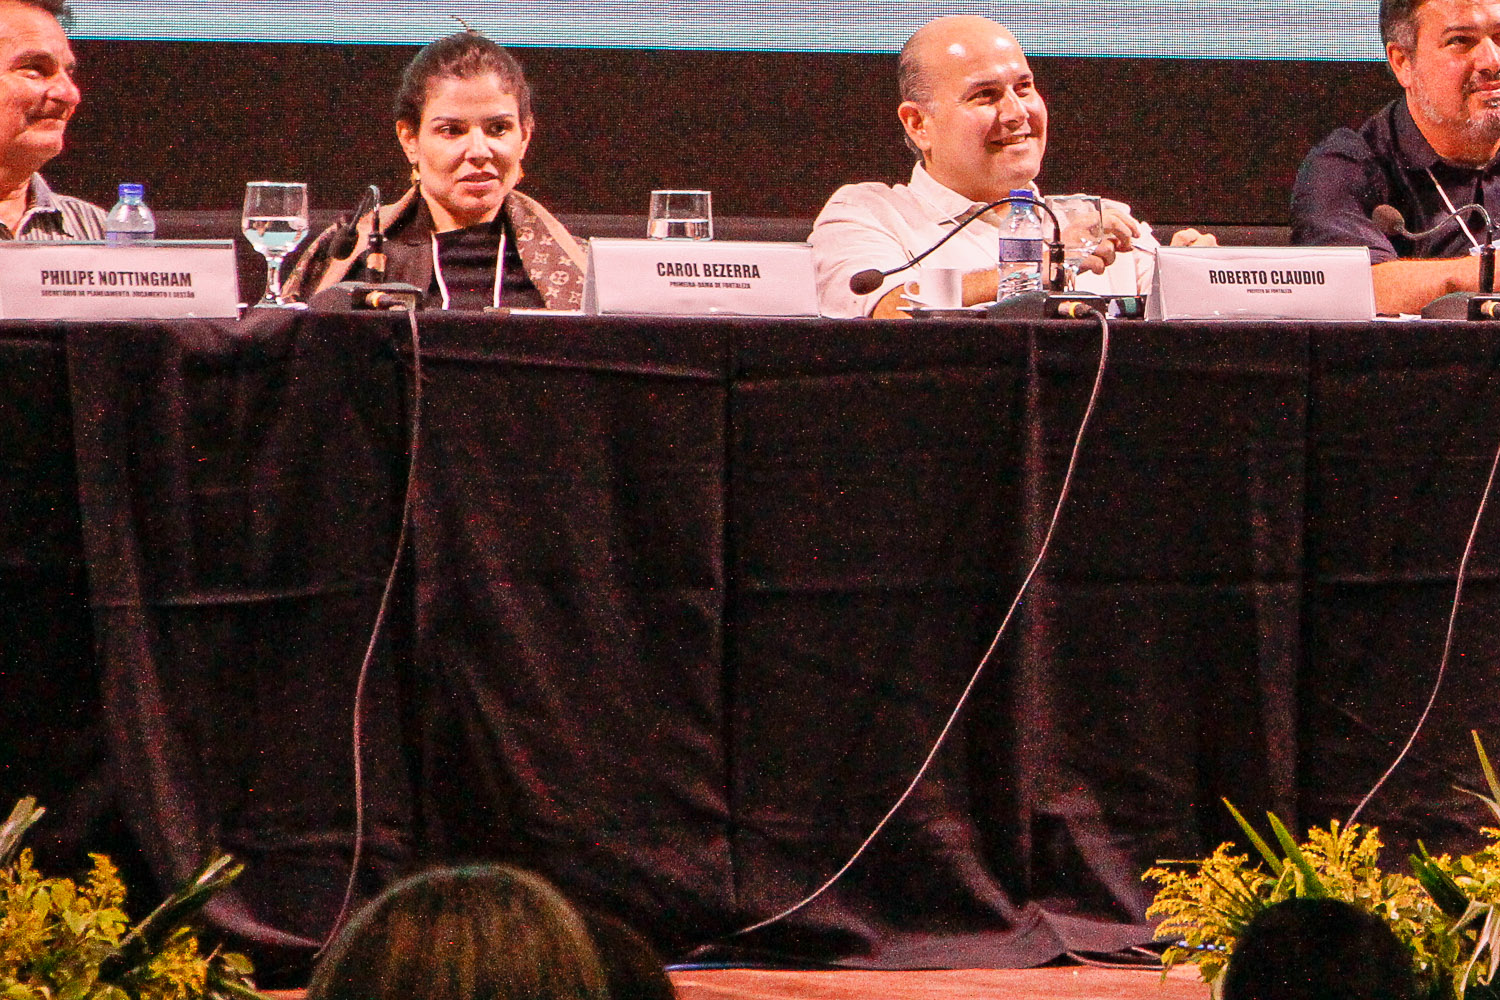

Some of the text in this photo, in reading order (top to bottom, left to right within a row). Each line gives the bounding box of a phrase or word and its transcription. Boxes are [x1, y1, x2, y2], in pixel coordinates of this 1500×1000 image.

[41, 270, 192, 287] PHILIPE NOTTINGHAM
[656, 262, 761, 279] CAROL BEZERRA
[1208, 269, 1325, 285] ROBERTO CLAUDIO
